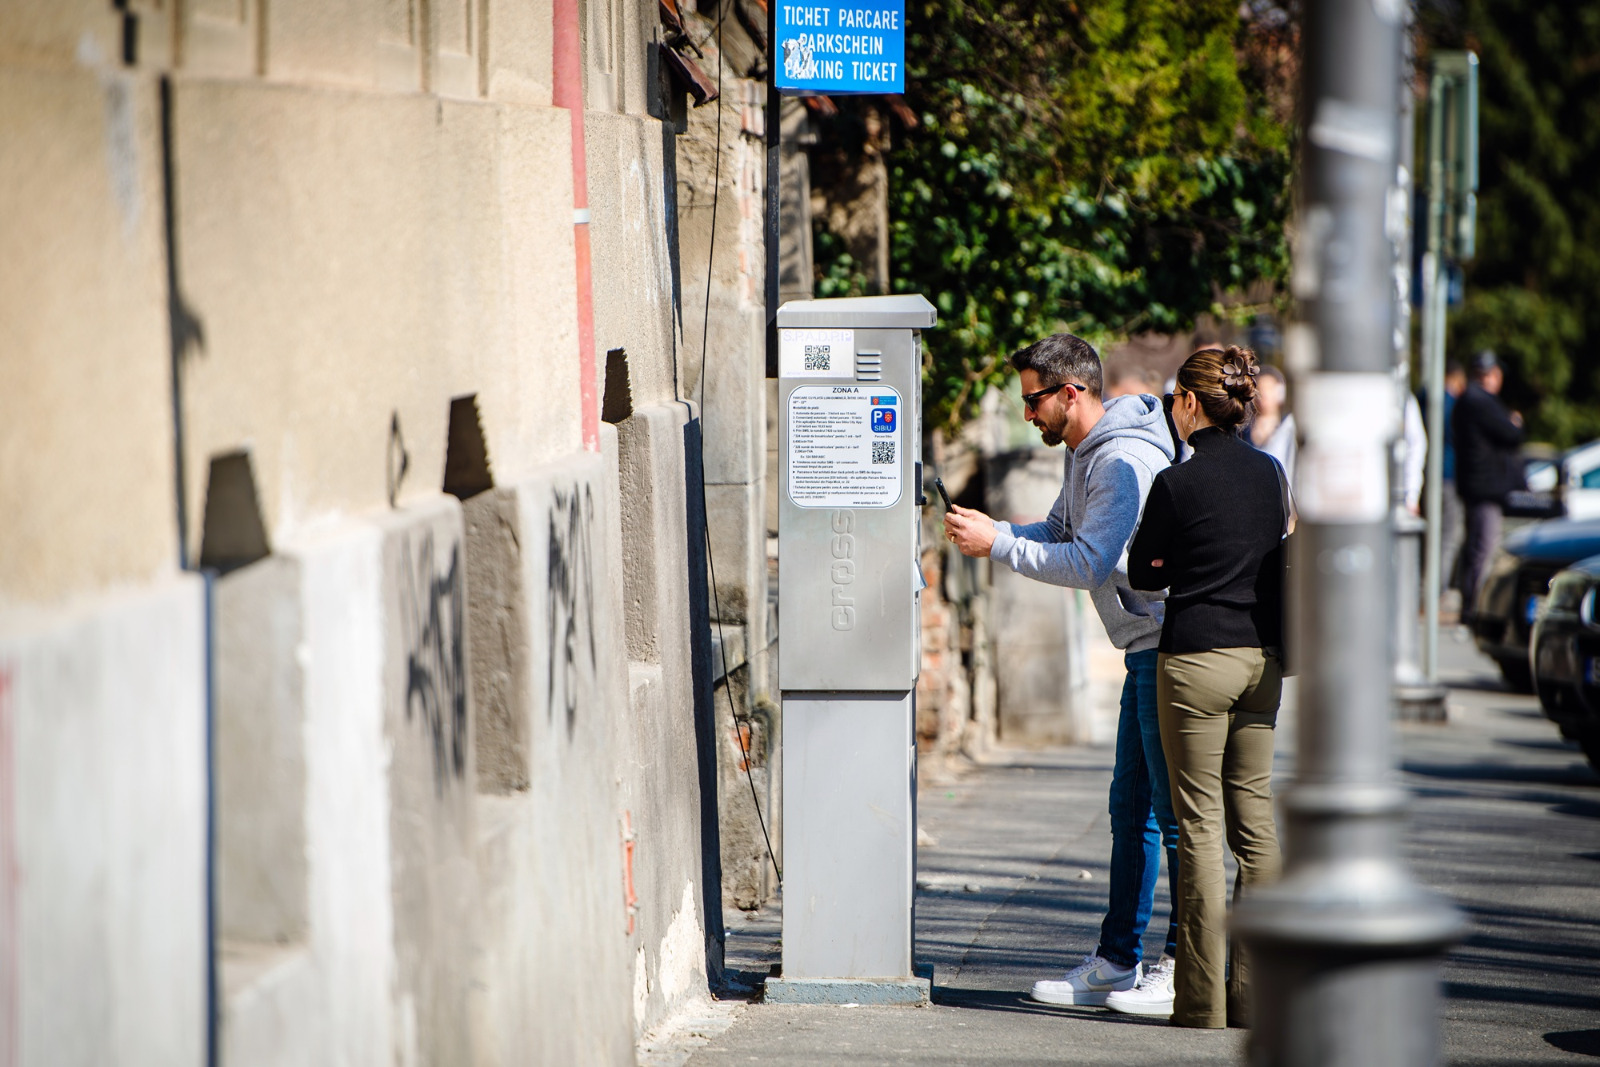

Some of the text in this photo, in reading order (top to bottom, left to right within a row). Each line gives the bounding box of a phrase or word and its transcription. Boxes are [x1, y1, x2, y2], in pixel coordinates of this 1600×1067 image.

[783, 5, 899, 30] TICHET PARCARE
[799, 32, 883, 55] PARKSCHEIN
[851, 61, 897, 82] TICKET
[874, 410, 883, 423] P
